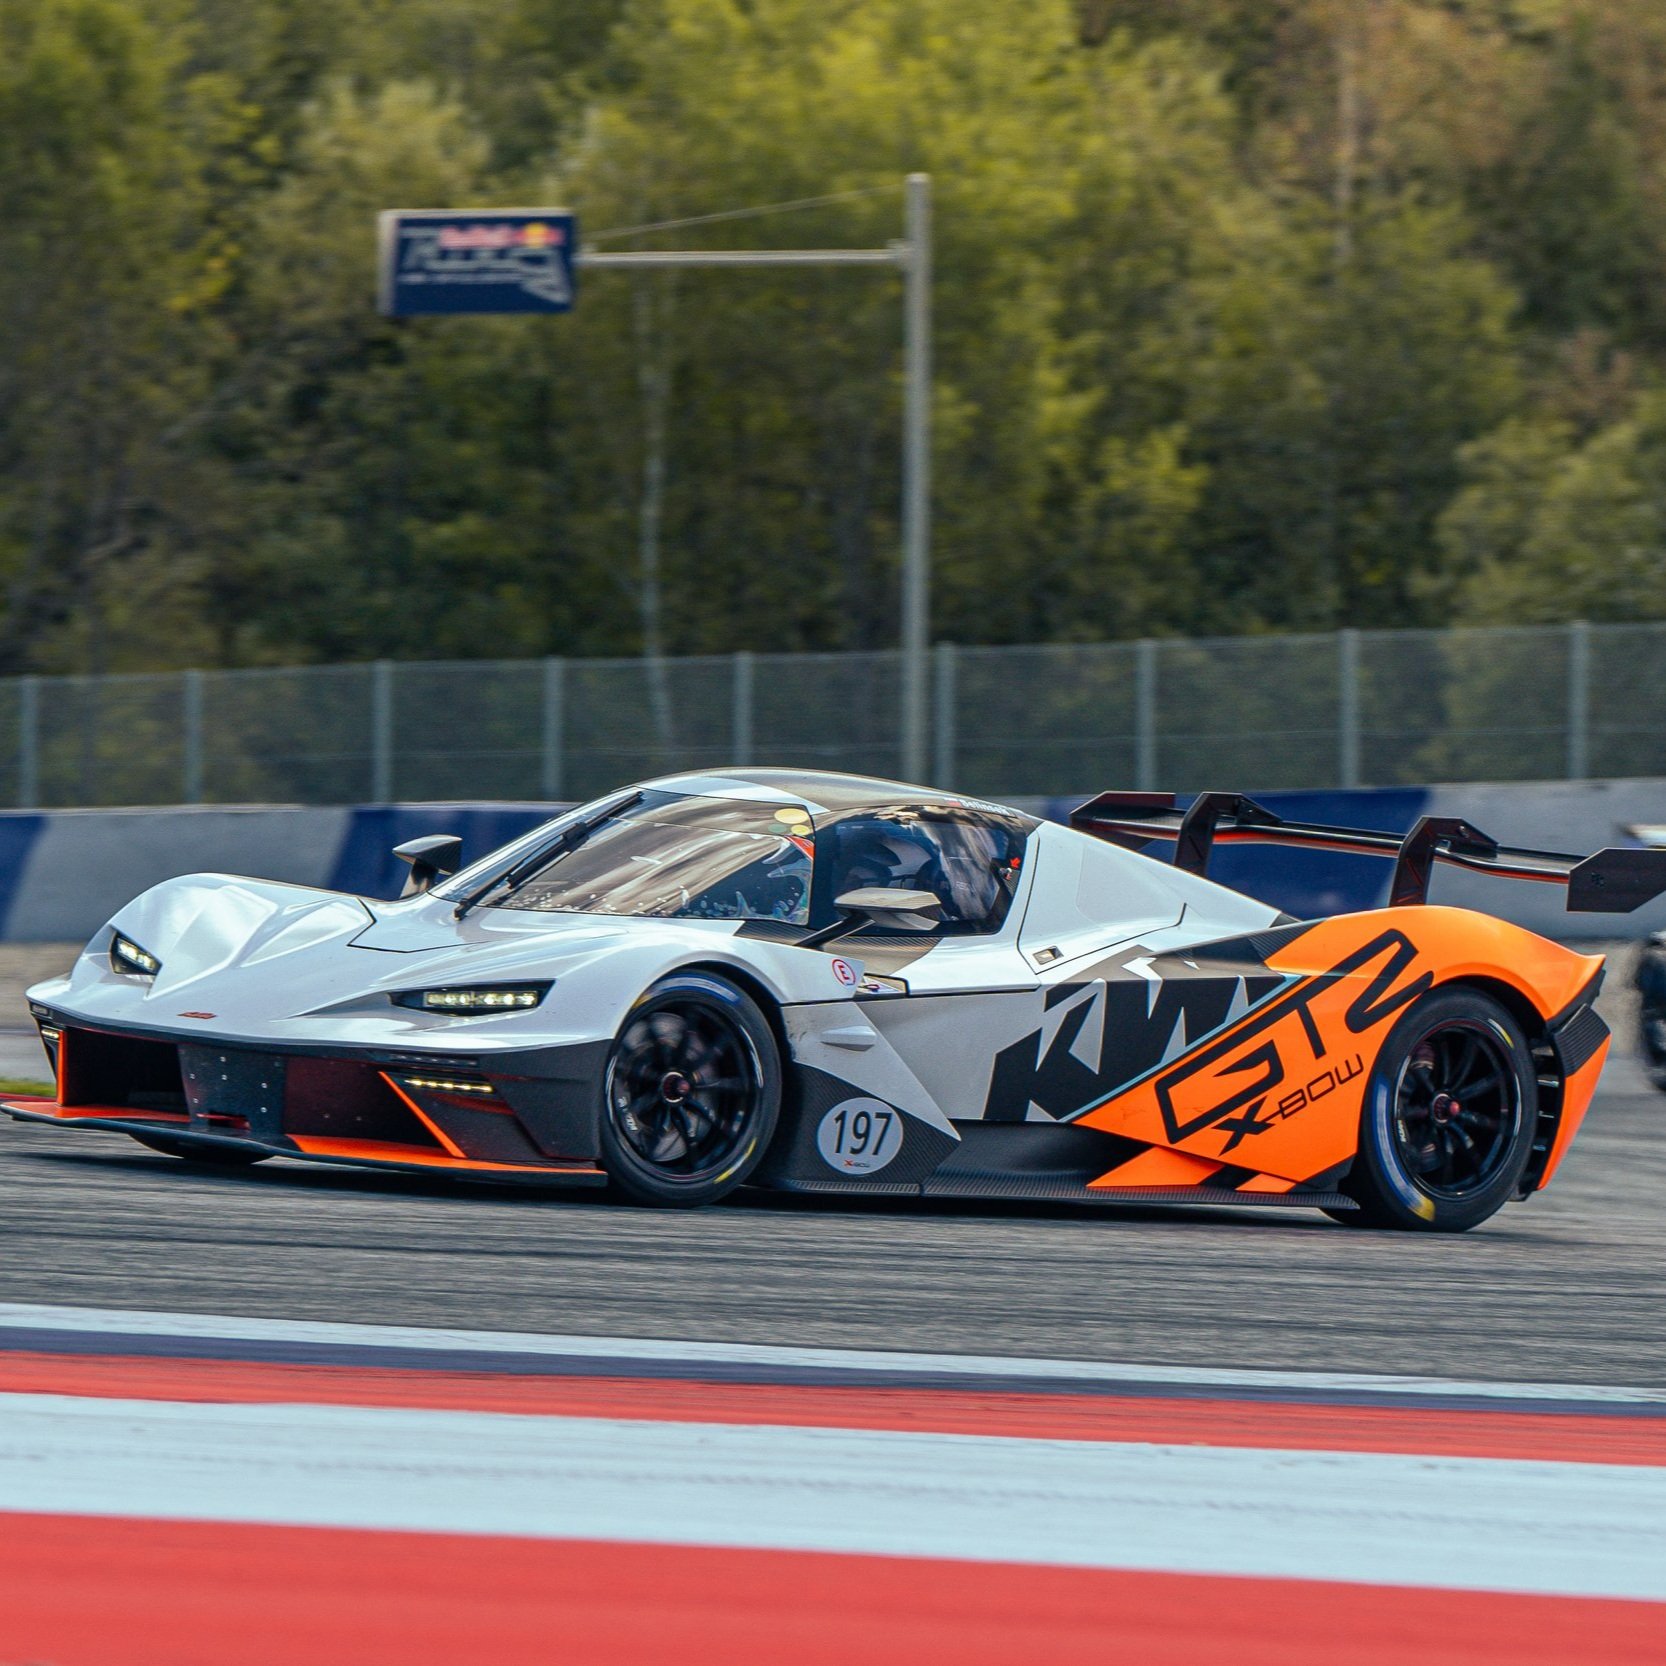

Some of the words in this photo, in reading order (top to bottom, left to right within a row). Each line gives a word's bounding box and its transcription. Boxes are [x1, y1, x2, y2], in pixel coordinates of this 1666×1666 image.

[983, 950, 1287, 1122] KTM
[835, 1111, 892, 1155] 197
[1211, 1053, 1364, 1156] X-BOW
